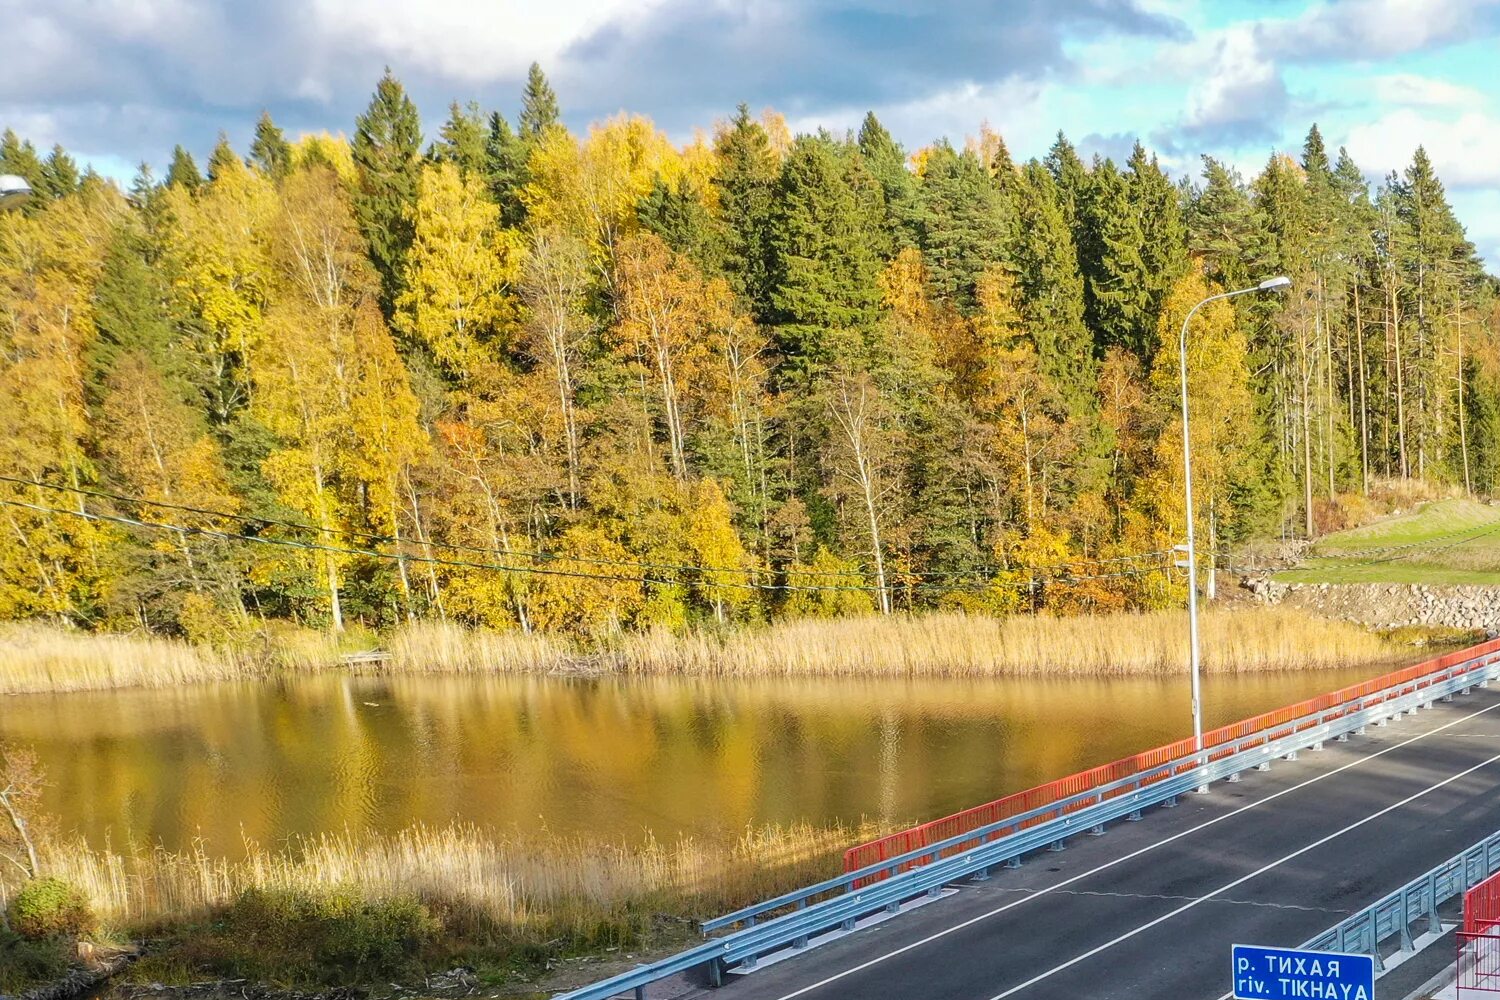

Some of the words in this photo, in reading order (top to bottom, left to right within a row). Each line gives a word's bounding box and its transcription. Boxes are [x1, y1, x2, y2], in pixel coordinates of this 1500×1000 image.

[1238, 957, 1255, 974] р.
[1265, 955, 1340, 977] ТИХАЯ
[1239, 976, 1269, 994] riv.
